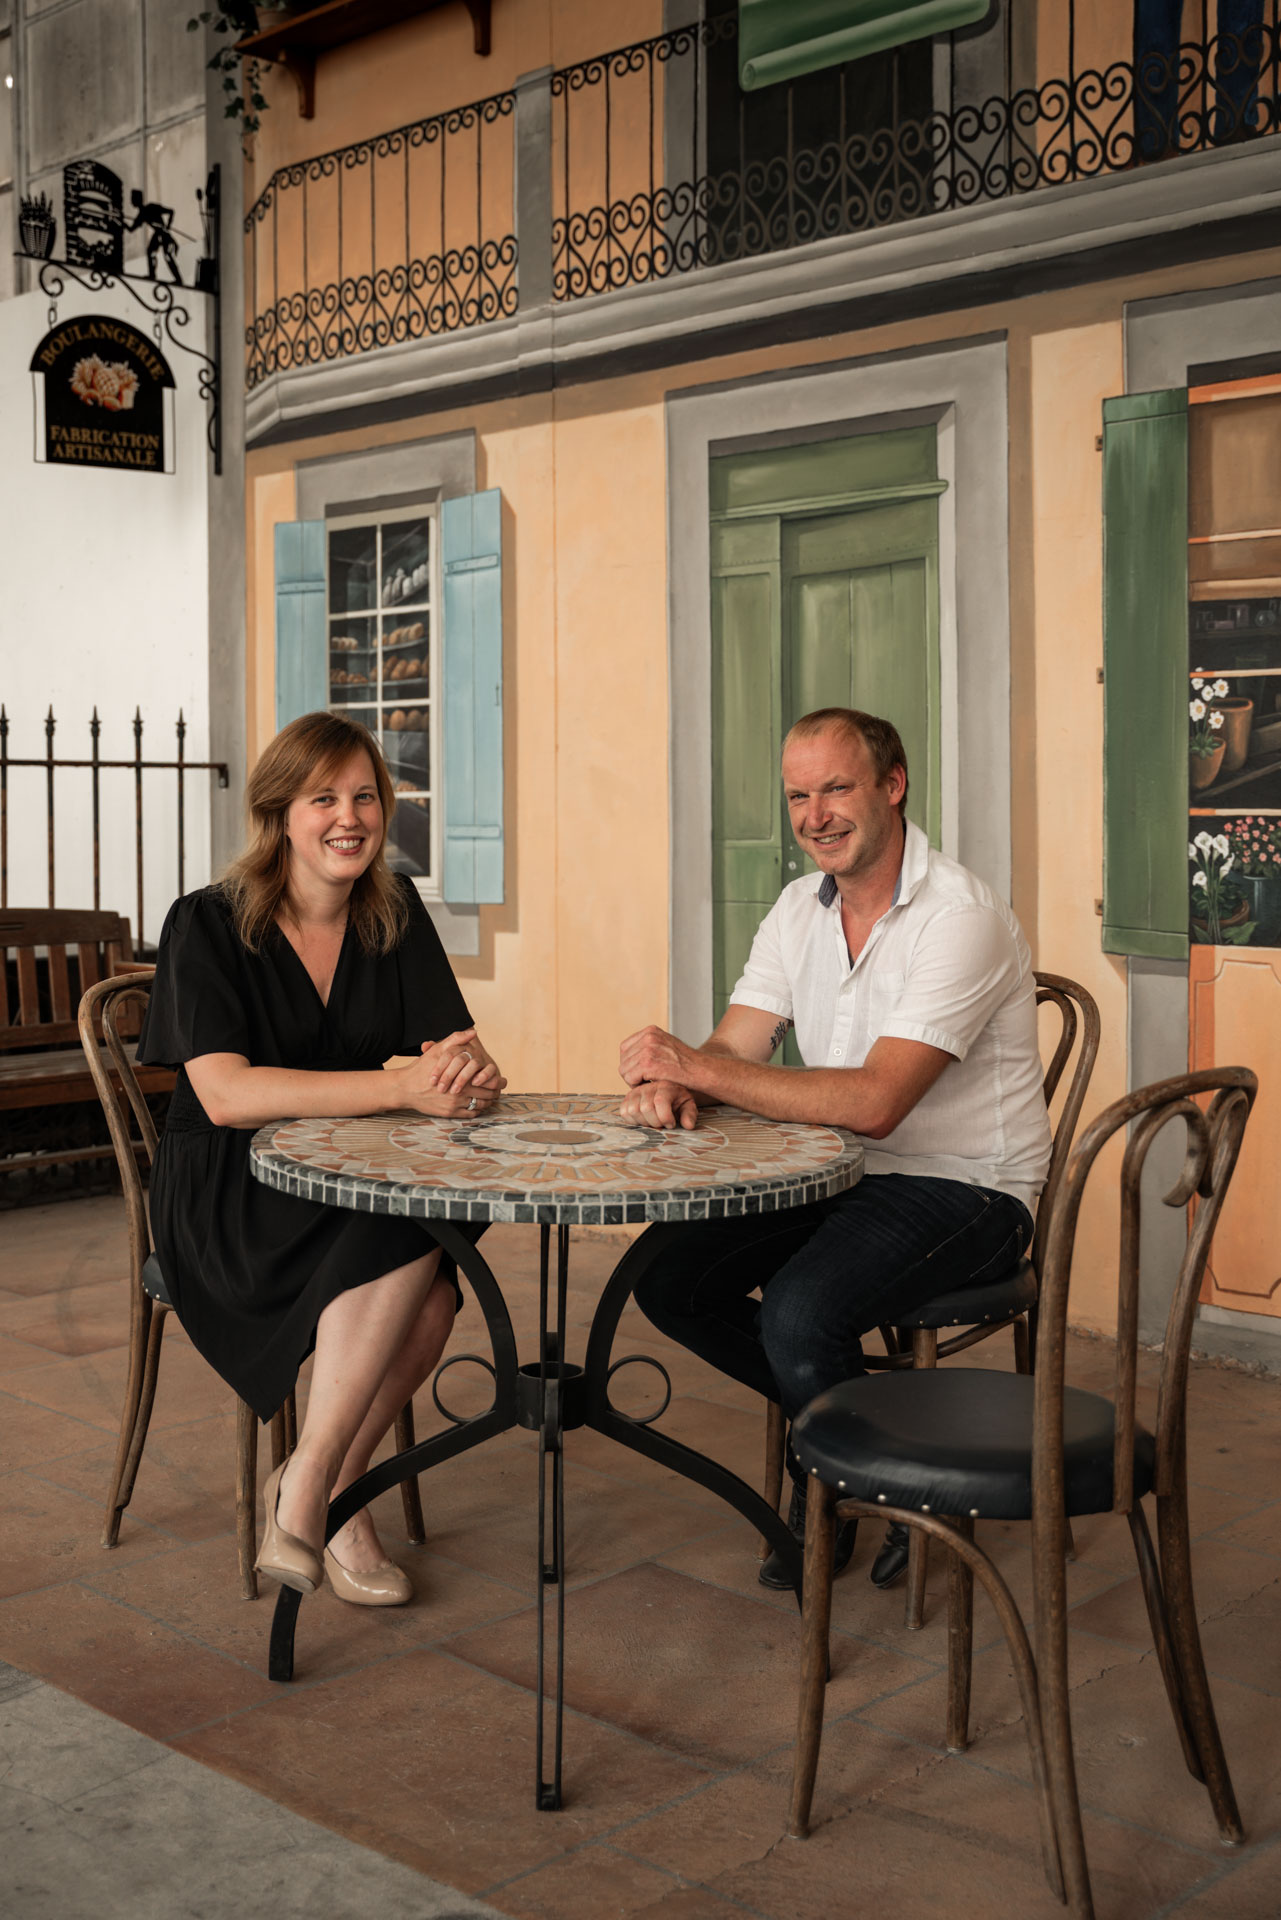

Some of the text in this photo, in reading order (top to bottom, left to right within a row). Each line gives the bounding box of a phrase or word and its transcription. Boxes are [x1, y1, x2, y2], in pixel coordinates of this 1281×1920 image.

[40, 323, 165, 380] BOULANGERIE
[50, 425, 159, 449] FABRICATION
[53, 444, 156, 465] ARTISANALE
